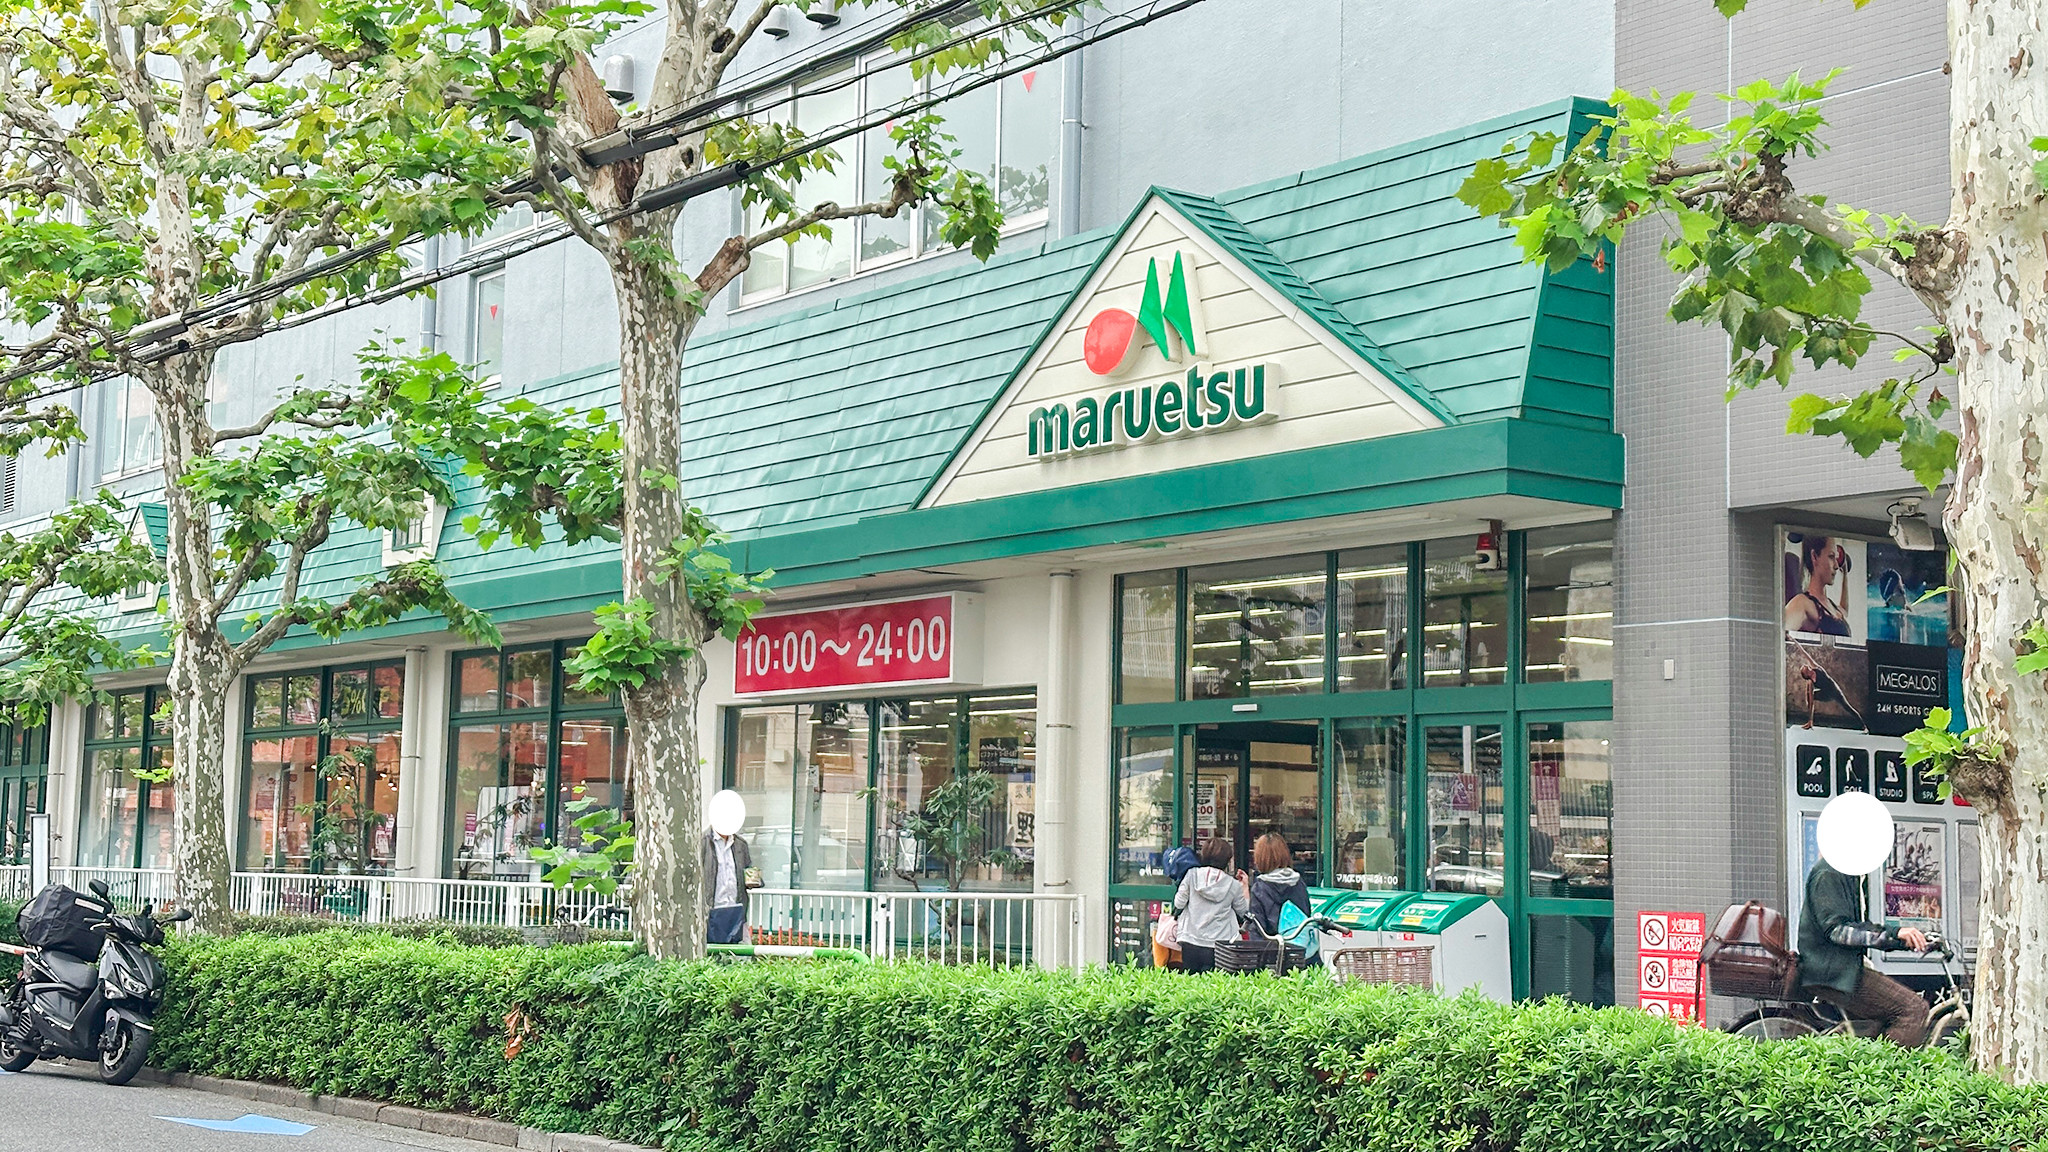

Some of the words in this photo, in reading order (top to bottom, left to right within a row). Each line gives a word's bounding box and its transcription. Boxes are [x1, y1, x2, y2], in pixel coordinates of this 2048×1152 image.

[1027, 363, 1266, 457] maruetsu
[1880, 672, 1937, 691] MEGALOS
[1877, 703, 1892, 713] 24H
[1894, 705, 1921, 715] SPORTS
[1804, 783, 1824, 793] POOL
[1879, 788, 1903, 798] STUDIO
[1923, 791, 1934, 800] SPA
[1677, 936, 1702, 946] OPEN
